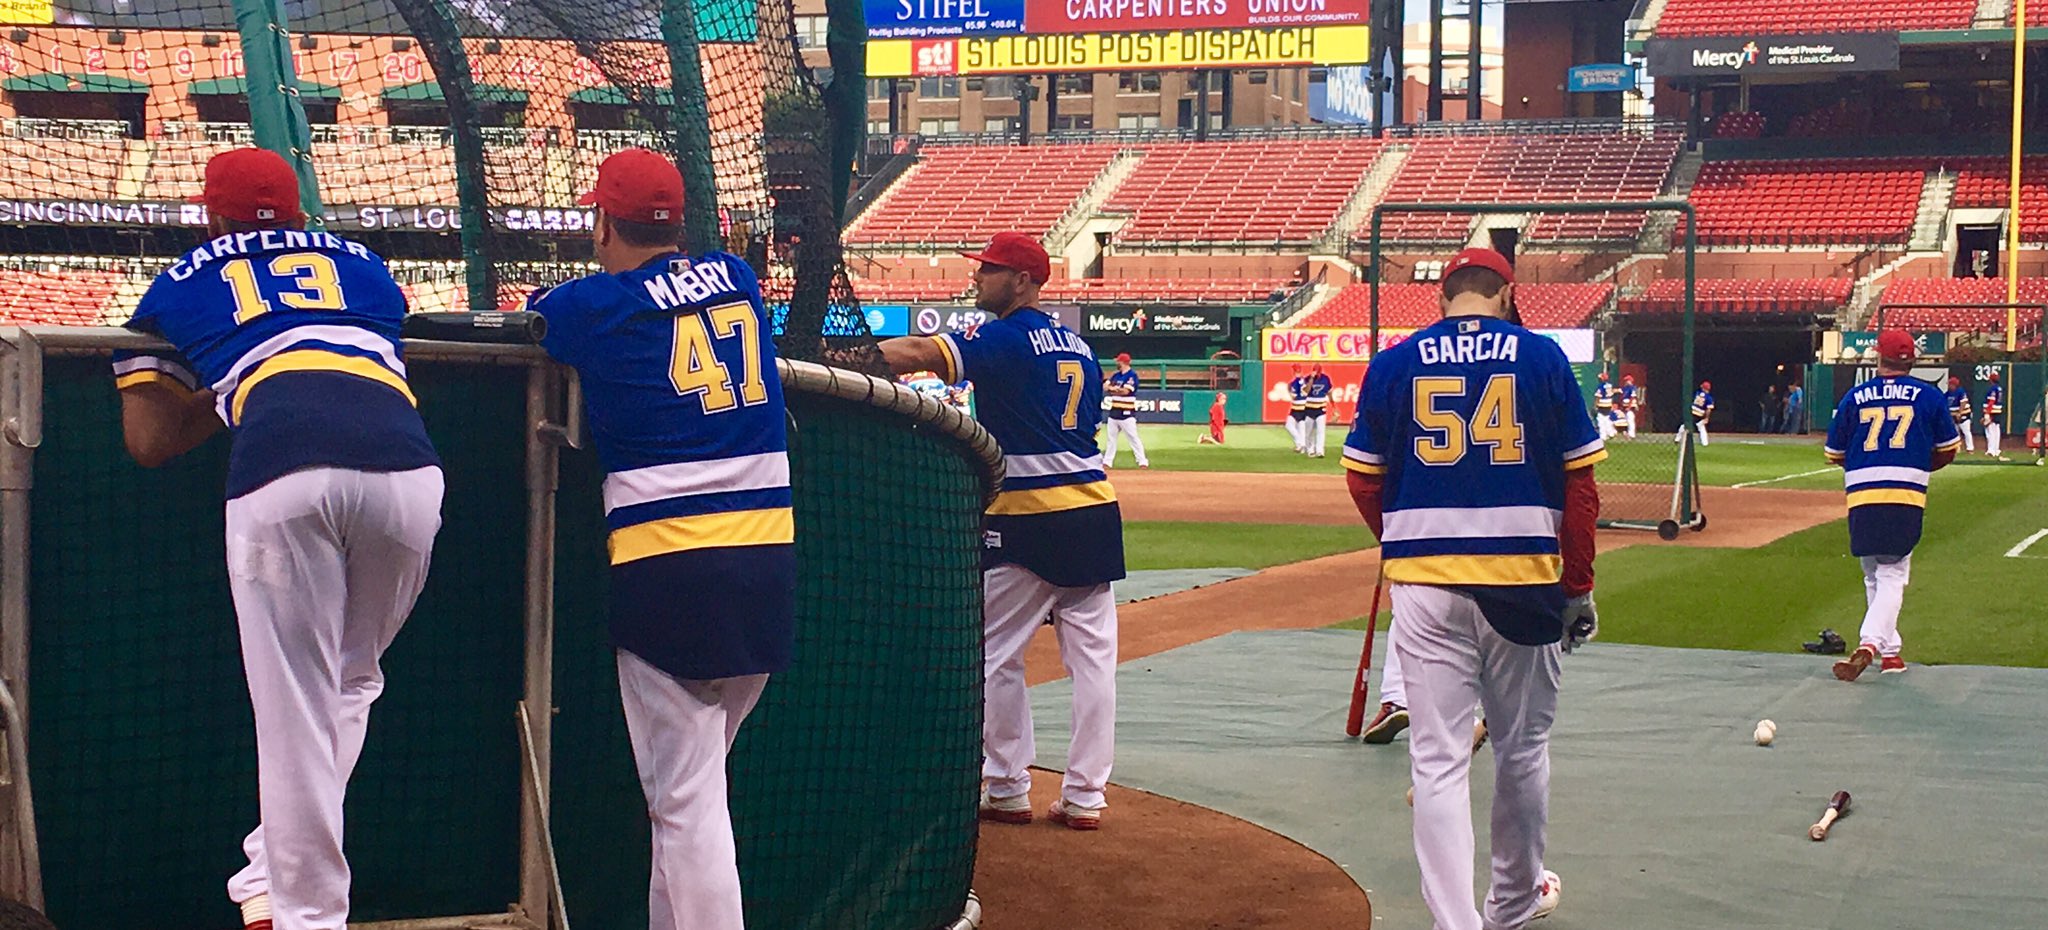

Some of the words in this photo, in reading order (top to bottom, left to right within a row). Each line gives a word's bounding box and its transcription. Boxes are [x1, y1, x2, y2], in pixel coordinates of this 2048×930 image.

[896, 0, 990, 20] STIFEL
[1066, 0, 1228, 20] CARPENTERS
[1247, 0, 1326, 14] UNION
[1248, 15, 1280, 24] BUILDS
[893, 27, 926, 37] Building
[927, 26, 963, 35] Products
[917, 41, 953, 66] stl
[968, 39, 1002, 67] ST.
[1011, 34, 1086, 66] LOUIS
[1099, 25, 1314, 64] POST-DISPATCH
[1768, 45, 1800, 55] Medical
[1801, 45, 1834, 54] Provider
[86, 46, 105, 75] 2
[131, 47, 150, 76] 6
[175, 48, 195, 76] 9
[328, 52, 359, 80] 17
[384, 53, 421, 82] 20
[1693, 49, 1746, 69] Mercy
[1768, 56, 1776, 64] of
[1777, 56, 1789, 64] the
[1800, 55, 1819, 63] Louis
[1820, 53, 1855, 63] Cardinals
[0, 202, 168, 225] CINCINNATI
[360, 207, 399, 229] ST.
[414, 208, 493, 229] LOU
[167, 230, 371, 282] CARPENTER
[220, 252, 347, 325] 13
[643, 260, 738, 310] MABRY
[946, 312, 986, 330] 4:52
[1089, 314, 1135, 334] Mercy
[1028, 328, 1093, 361] HOLLIDA
[1270, 331, 1329, 356] DIRT
[1417, 332, 1519, 365] GARCIA
[668, 299, 768, 415] 47
[1056, 360, 1085, 430] 7
[1135, 400, 1155, 412] FS1
[1159, 400, 1181, 412] FOX
[1854, 384, 1923, 405] MALONEY
[1413, 374, 1526, 466] 54
[1859, 405, 1915, 451] 77
